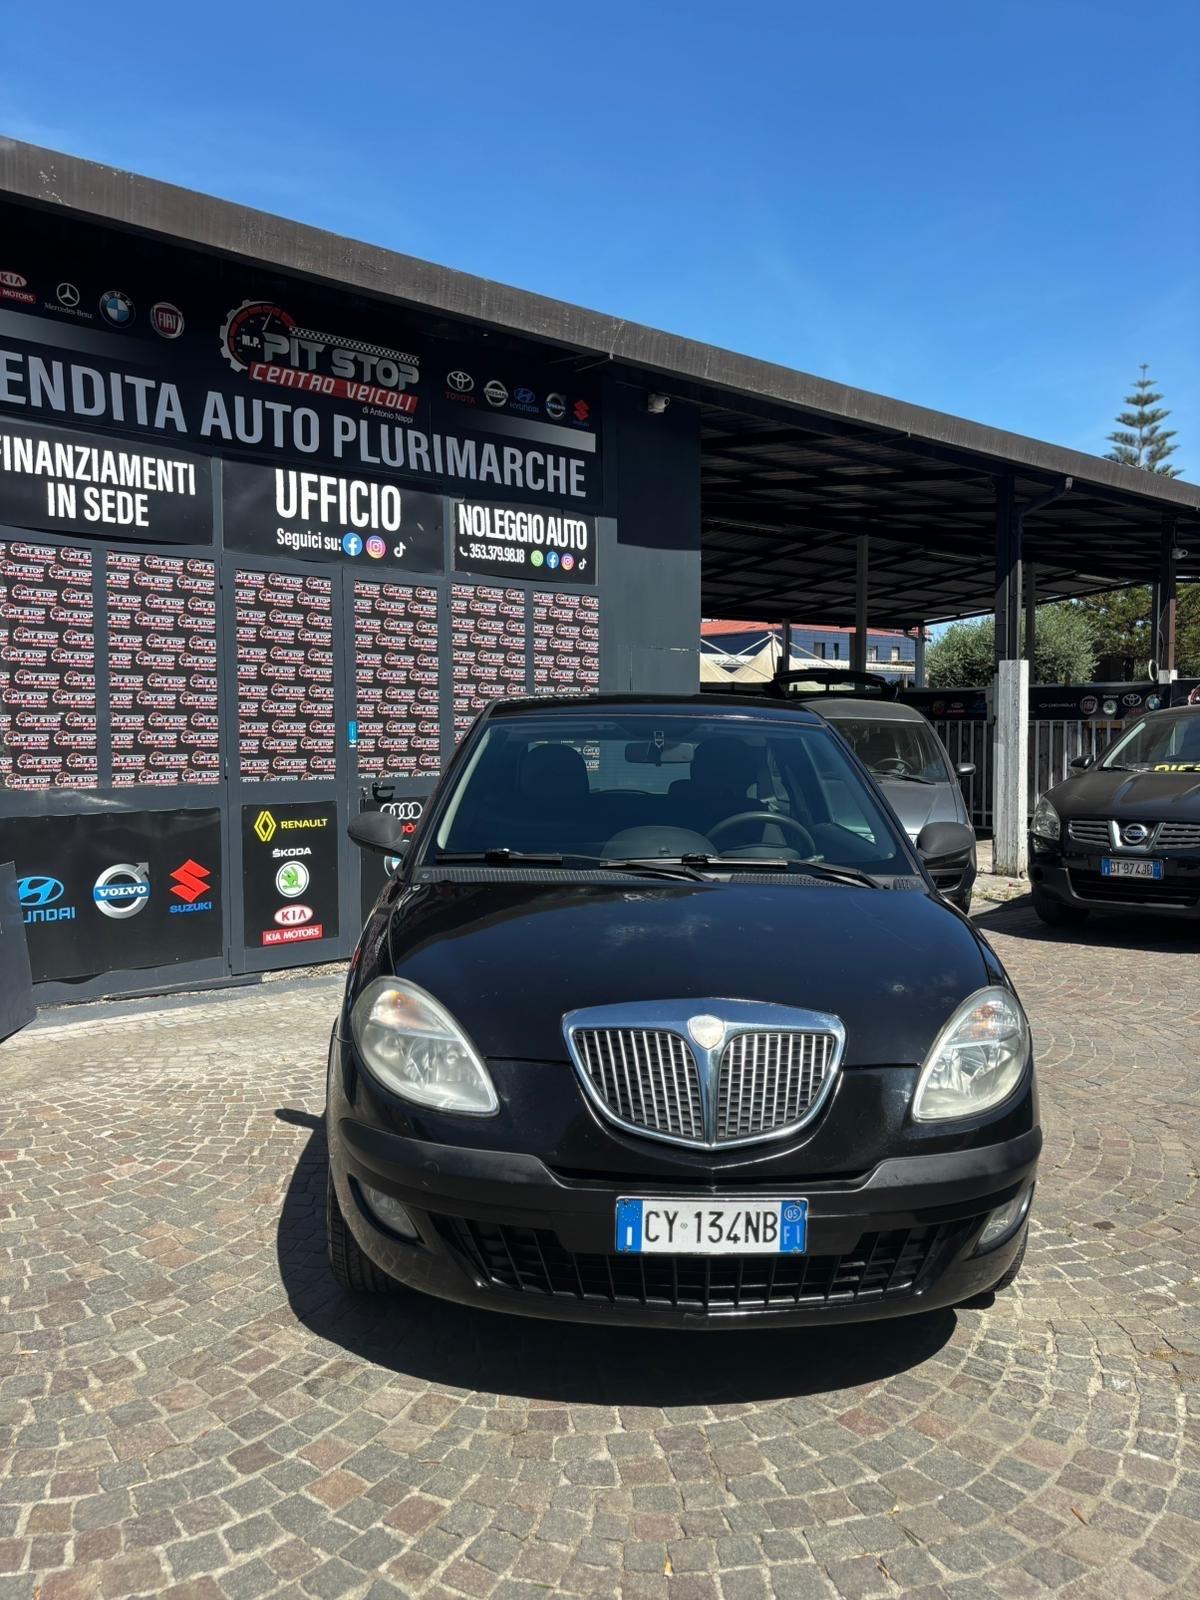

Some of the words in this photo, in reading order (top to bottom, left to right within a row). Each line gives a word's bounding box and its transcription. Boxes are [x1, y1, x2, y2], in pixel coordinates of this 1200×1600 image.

[2, 289, 34, 302] MOTORS
[158, 312, 177, 330] FIAT
[262, 332, 326, 371] PIT
[330, 348, 420, 391] STOP
[0, 350, 188, 433] ENDITA
[200, 390, 320, 454] AUTO
[334, 414, 586, 498] PLURIMARCHE
[362, 406, 368, 414] di
[370, 408, 394, 420] Antonio
[396, 412, 414, 424] Nappi
[0, 434, 196, 496] INANZIAMENTI
[48, 482, 76, 519] IN
[83, 486, 150, 527] SEDE
[276, 468, 402, 532] UFFICIO
[458, 504, 544, 546] NOLEGGIO
[546, 516, 588, 550] AUTO
[276, 528, 322, 552] Seguici
[324, 534, 342, 552] su:
[469, 543, 525, 564] 353.379.98.18
[280, 818, 328, 830] RENAULT
[98, 886, 146, 898] VOLVO
[23, 906, 76, 924] UNDAI
[170, 902, 212, 914] SUZUKI
[281, 911, 307, 922] KIA
[266, 932, 281, 942] KIA
[283, 928, 320, 940] MOTORS
[644, 1210, 679, 1243] CY
[694, 1210, 778, 1244] 134NB
